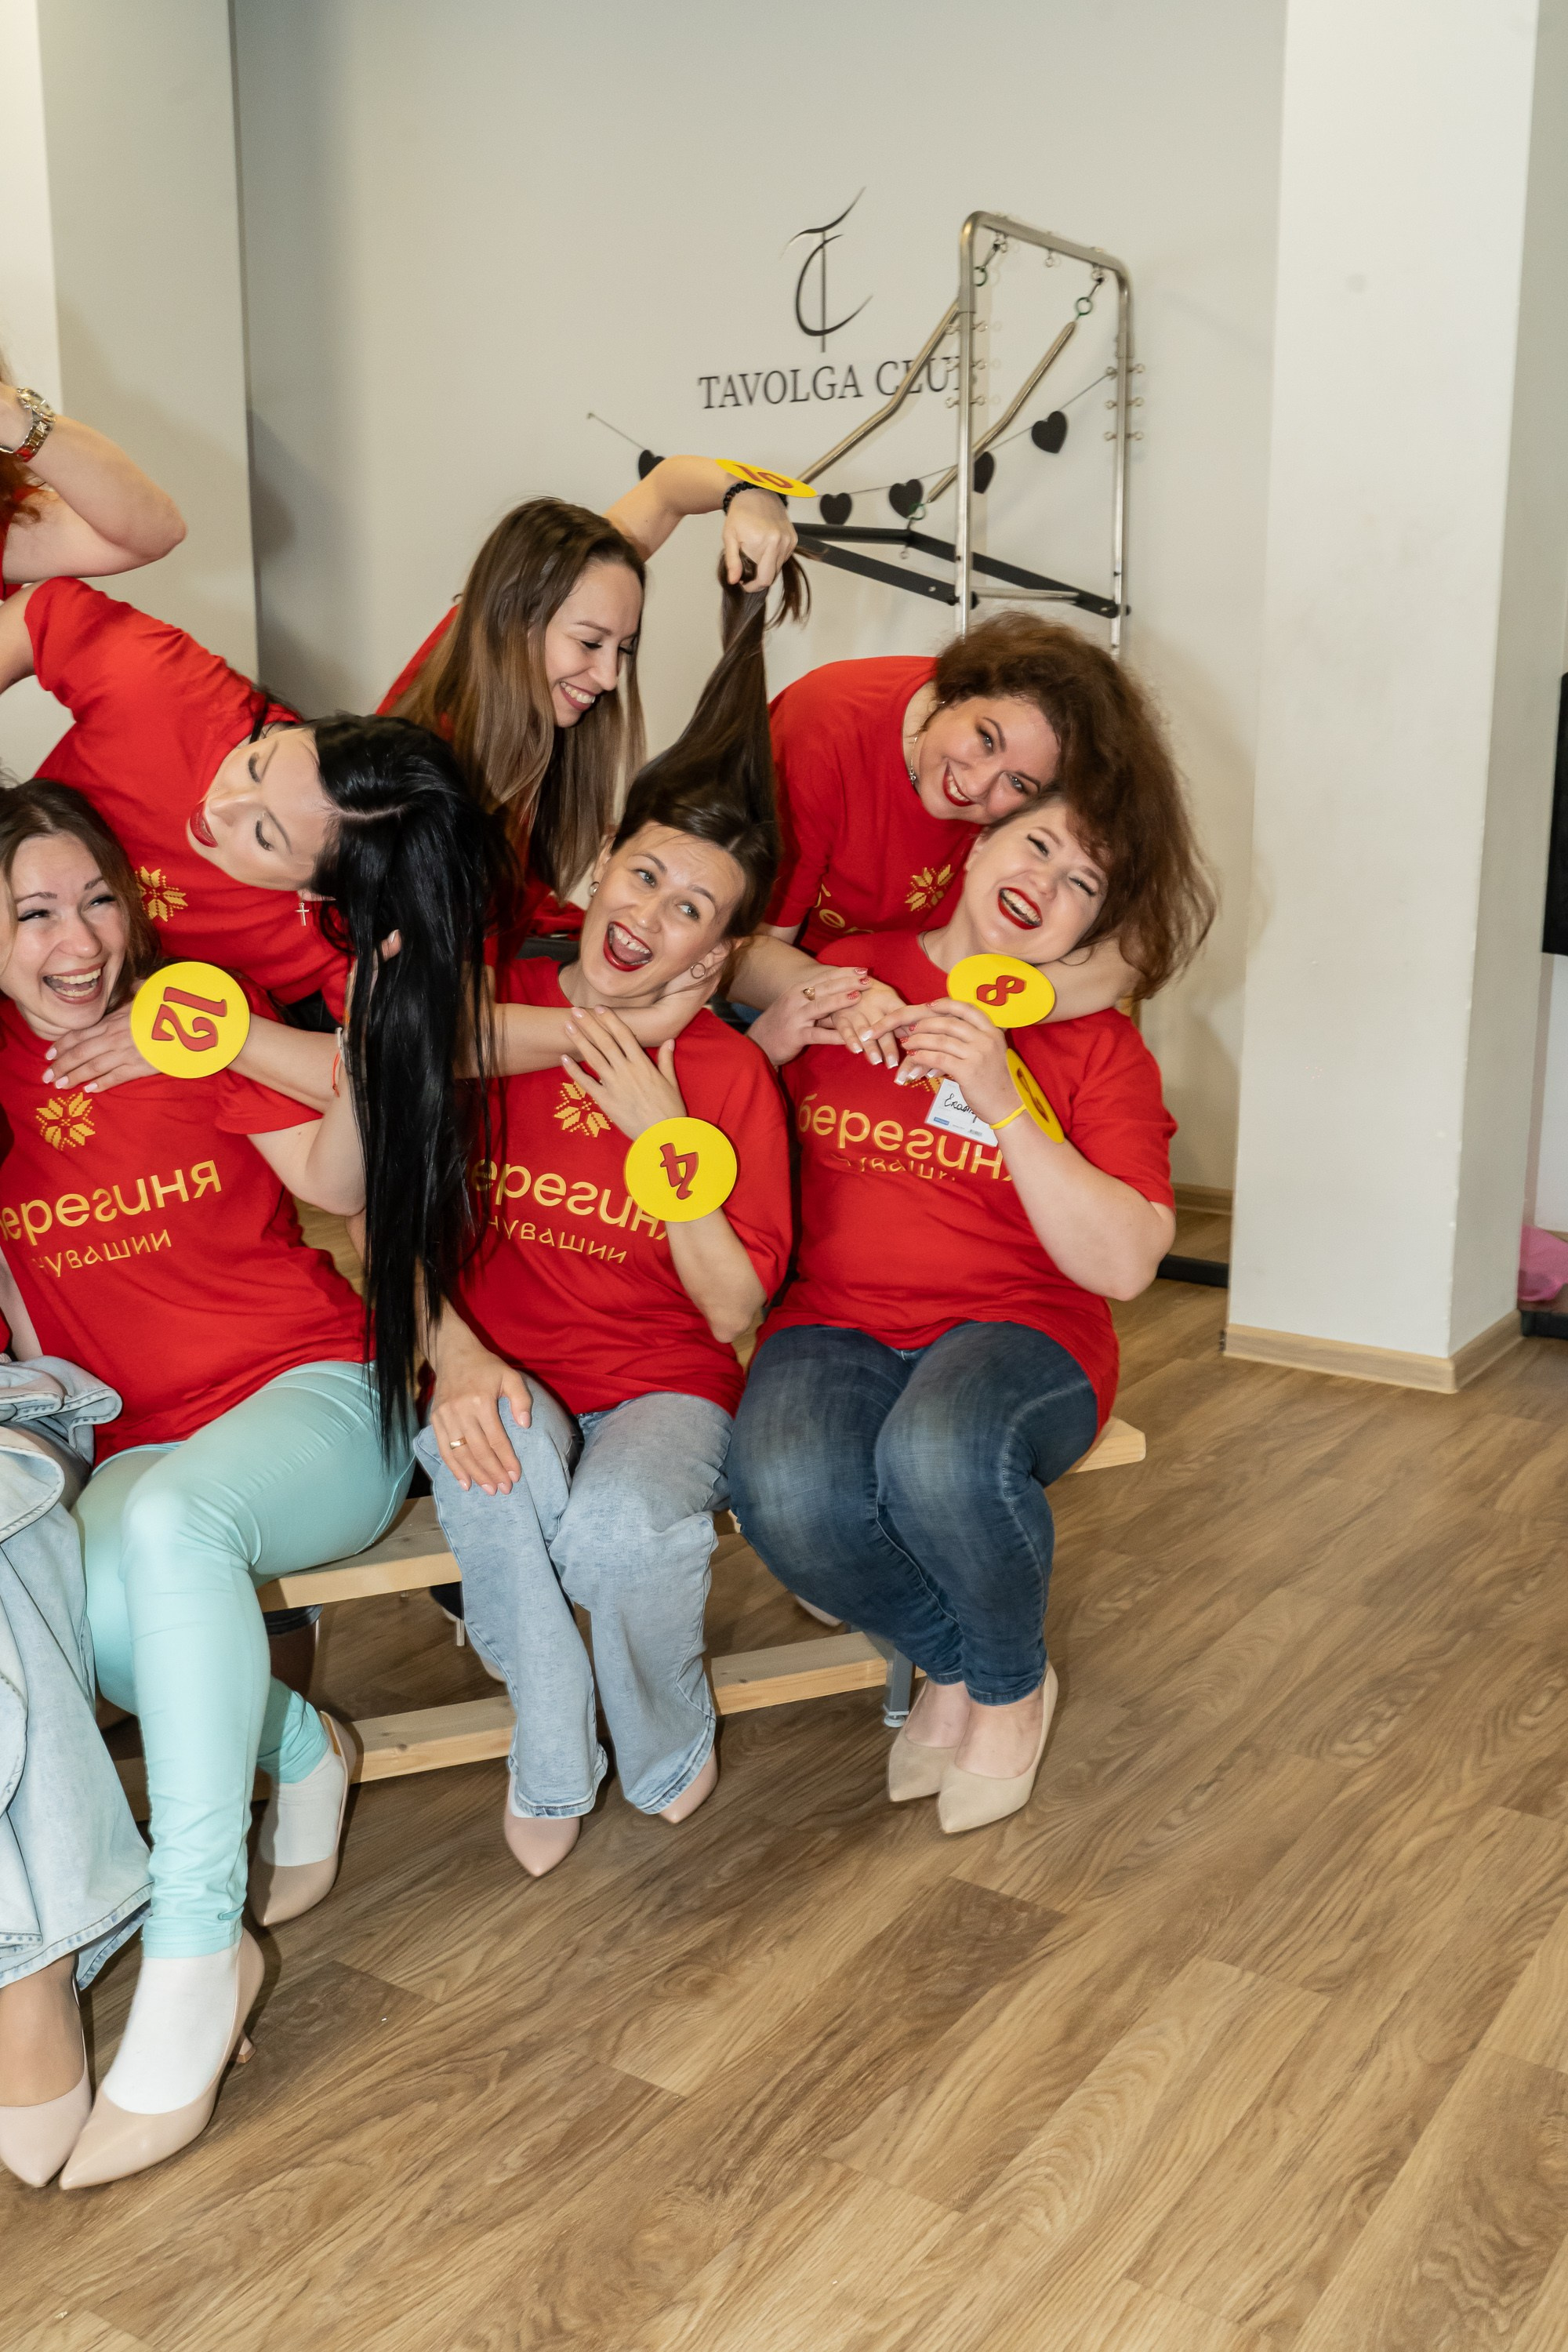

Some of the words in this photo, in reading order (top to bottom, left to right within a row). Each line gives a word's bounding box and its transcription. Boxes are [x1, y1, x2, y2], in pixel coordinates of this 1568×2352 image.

[697, 364, 864, 409] TAVOLGA
[151, 986, 227, 1051] 12
[976, 975, 1027, 1007] 8
[798, 1093, 1014, 1182] берегин
[0, 1160, 222, 1247] ерегиня
[471, 1159, 667, 1240] ерегин
[659, 1142, 699, 1200] 4
